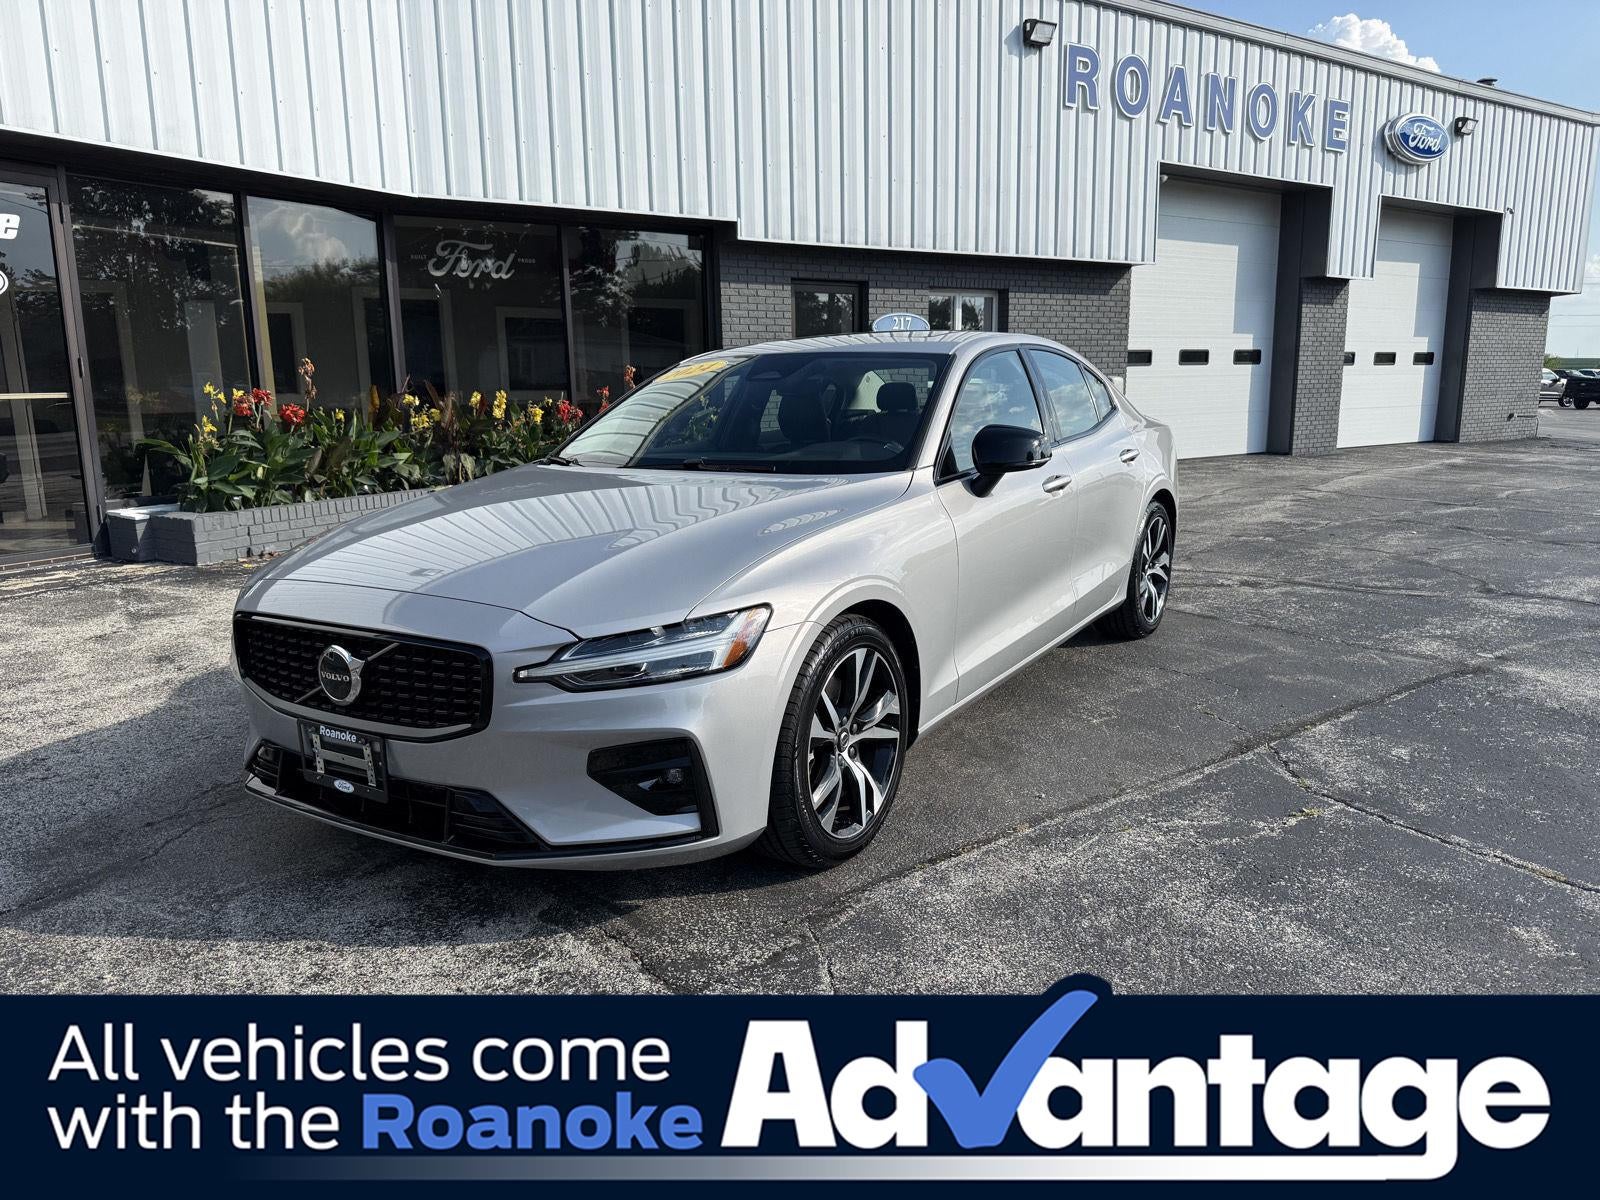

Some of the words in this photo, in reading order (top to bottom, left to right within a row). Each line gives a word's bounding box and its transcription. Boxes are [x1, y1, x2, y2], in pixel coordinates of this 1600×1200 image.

[1065, 42, 1350, 153] ROANOKE
[1408, 122, 1443, 153] Ford
[427, 239, 516, 280] Ford
[892, 316, 912, 331] 217
[320, 671, 350, 682] VOLVO
[319, 725, 357, 743] Roanoke
